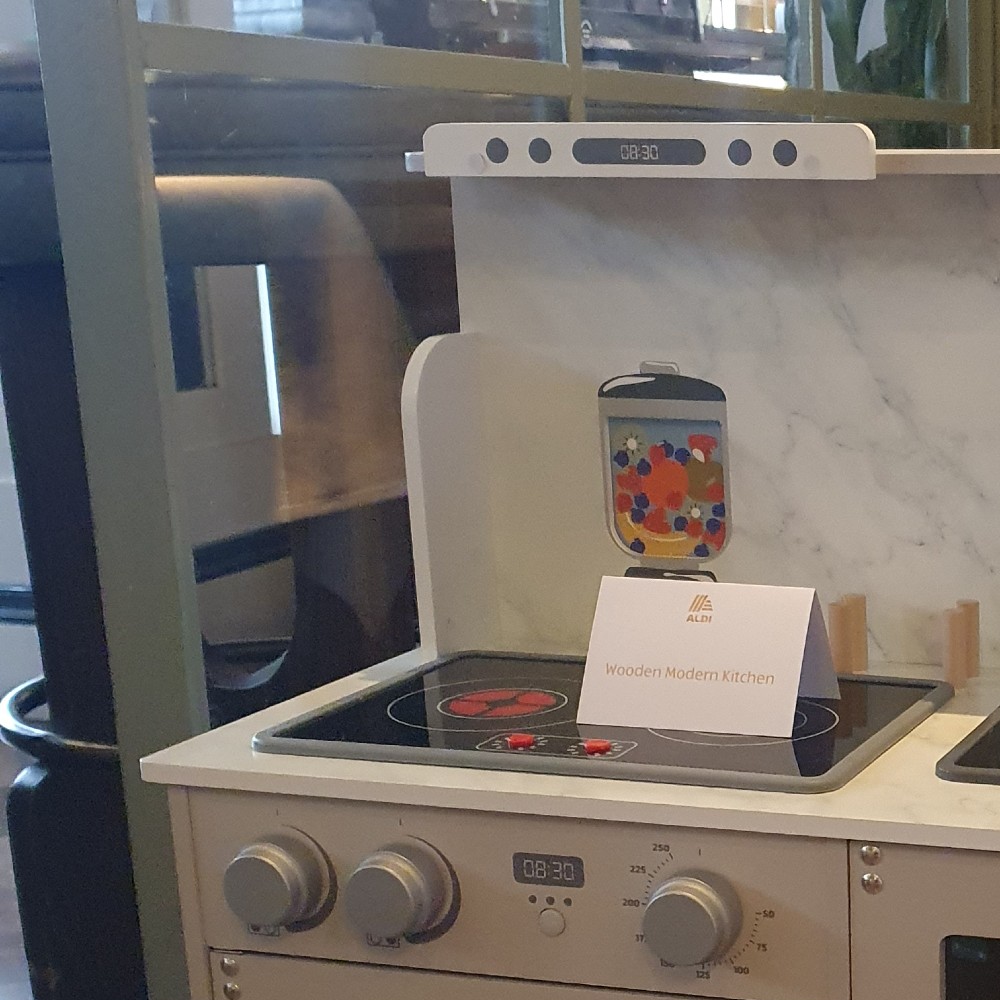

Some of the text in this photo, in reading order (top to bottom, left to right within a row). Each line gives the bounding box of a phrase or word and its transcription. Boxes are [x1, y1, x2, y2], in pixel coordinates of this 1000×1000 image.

[621, 144, 659, 160] 08:30
[686, 614, 712, 624] ALDI
[605, 662, 775, 685] Wooden Modern Kitchen
[652, 843, 670, 852] 250
[523, 859, 575, 880] 08:30
[630, 866, 646, 874] 225
[622, 898, 640, 908] 200
[762, 910, 775, 918] 50
[757, 943, 768, 952] 75
[696, 970, 711, 979] 125
[734, 966, 750, 975] 100
